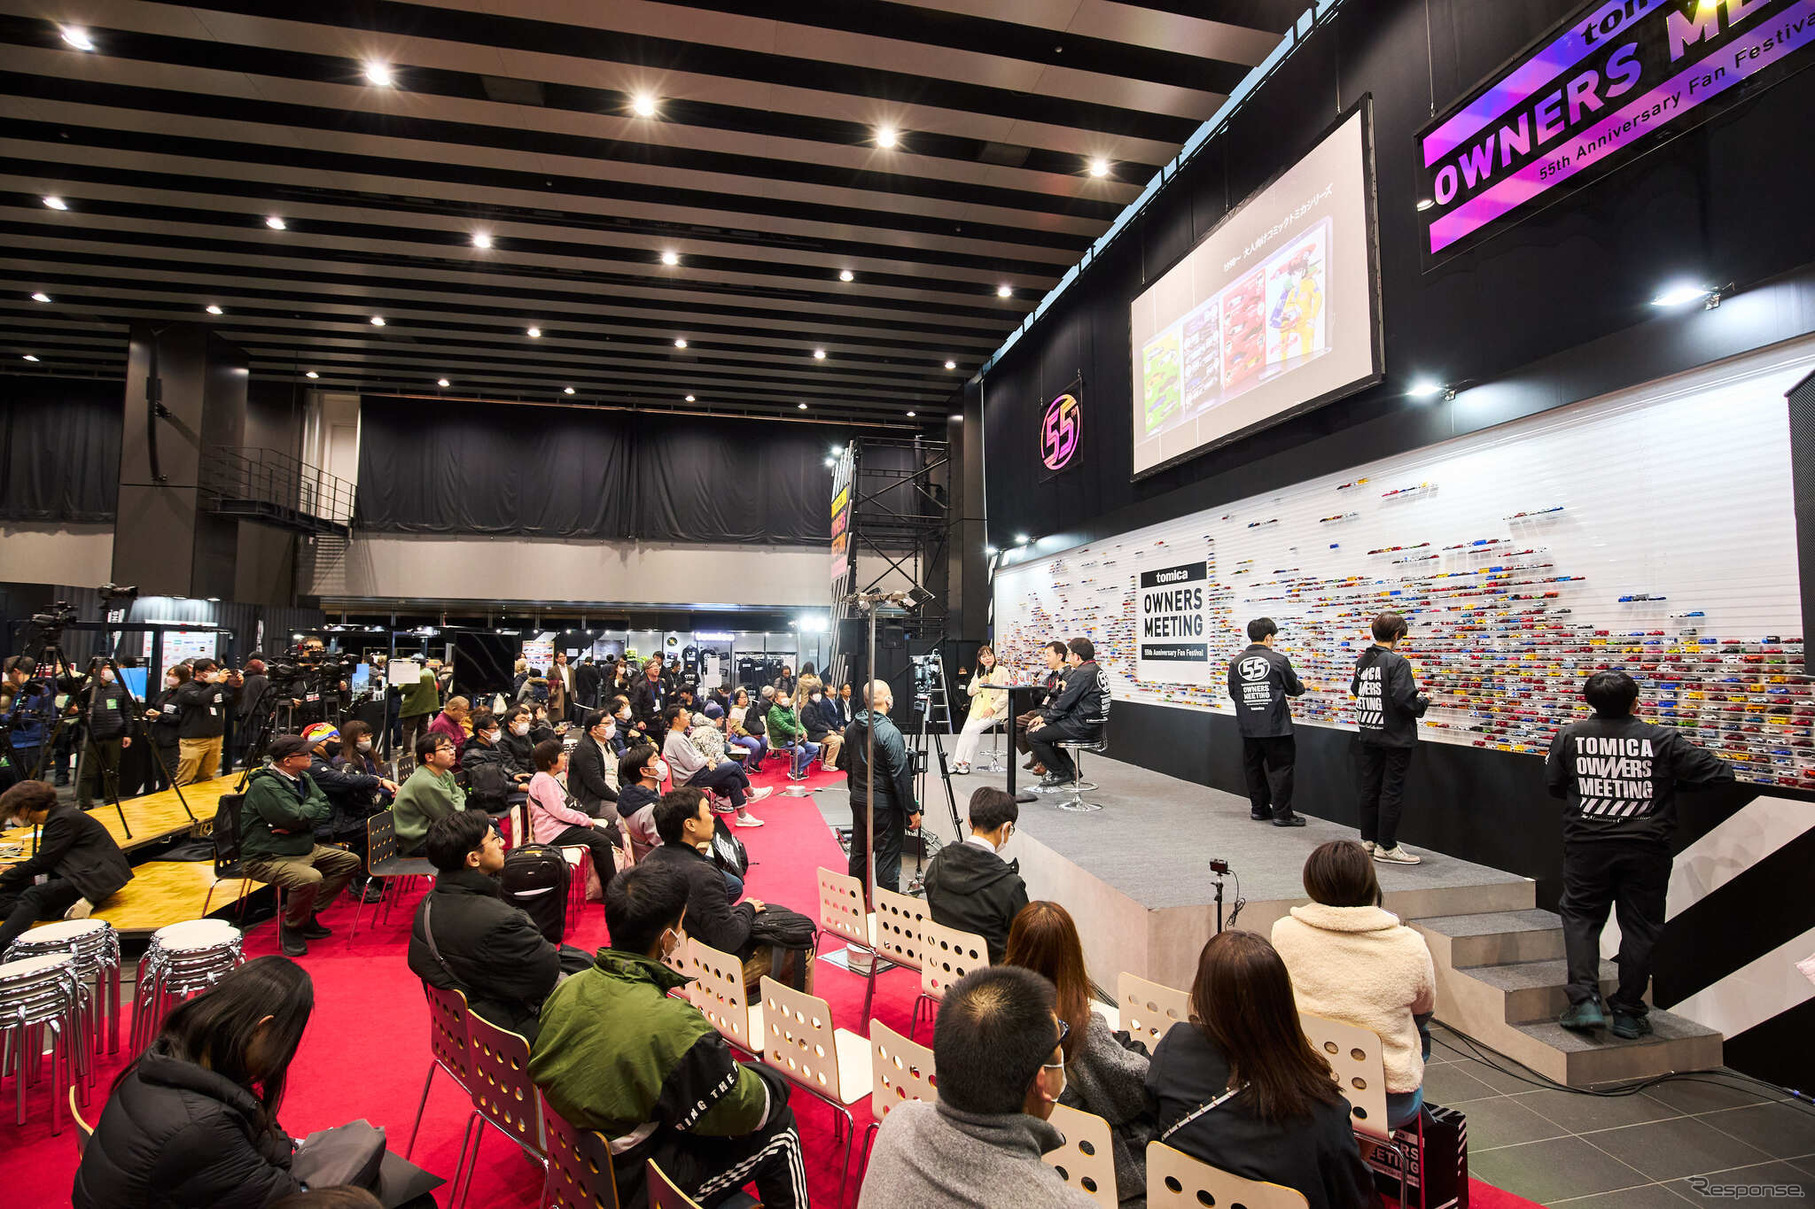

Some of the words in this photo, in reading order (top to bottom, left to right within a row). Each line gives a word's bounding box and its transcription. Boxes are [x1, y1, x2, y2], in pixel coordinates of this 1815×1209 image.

[1434, 42, 1642, 206] OWNERS
[1539, 156, 1570, 180] 55th
[1576, 91, 1681, 160] Anniversary
[1689, 66, 1725, 95] Fan
[1156, 569, 1188, 583] tomica
[1144, 588, 1203, 613] OWNERS
[1144, 614, 1203, 637] MEETING
[1153, 649, 1177, 657] Anniversary
[1186, 649, 1204, 657] Festival
[1242, 685, 1270, 694] OWNERS
[1243, 692, 1271, 700] MEETING
[1575, 737, 1653, 757] TOMICA
[1576, 757, 1652, 778] OWNERS
[1578, 778, 1653, 799] MEETING
[710, 1073, 735, 1099] THE
